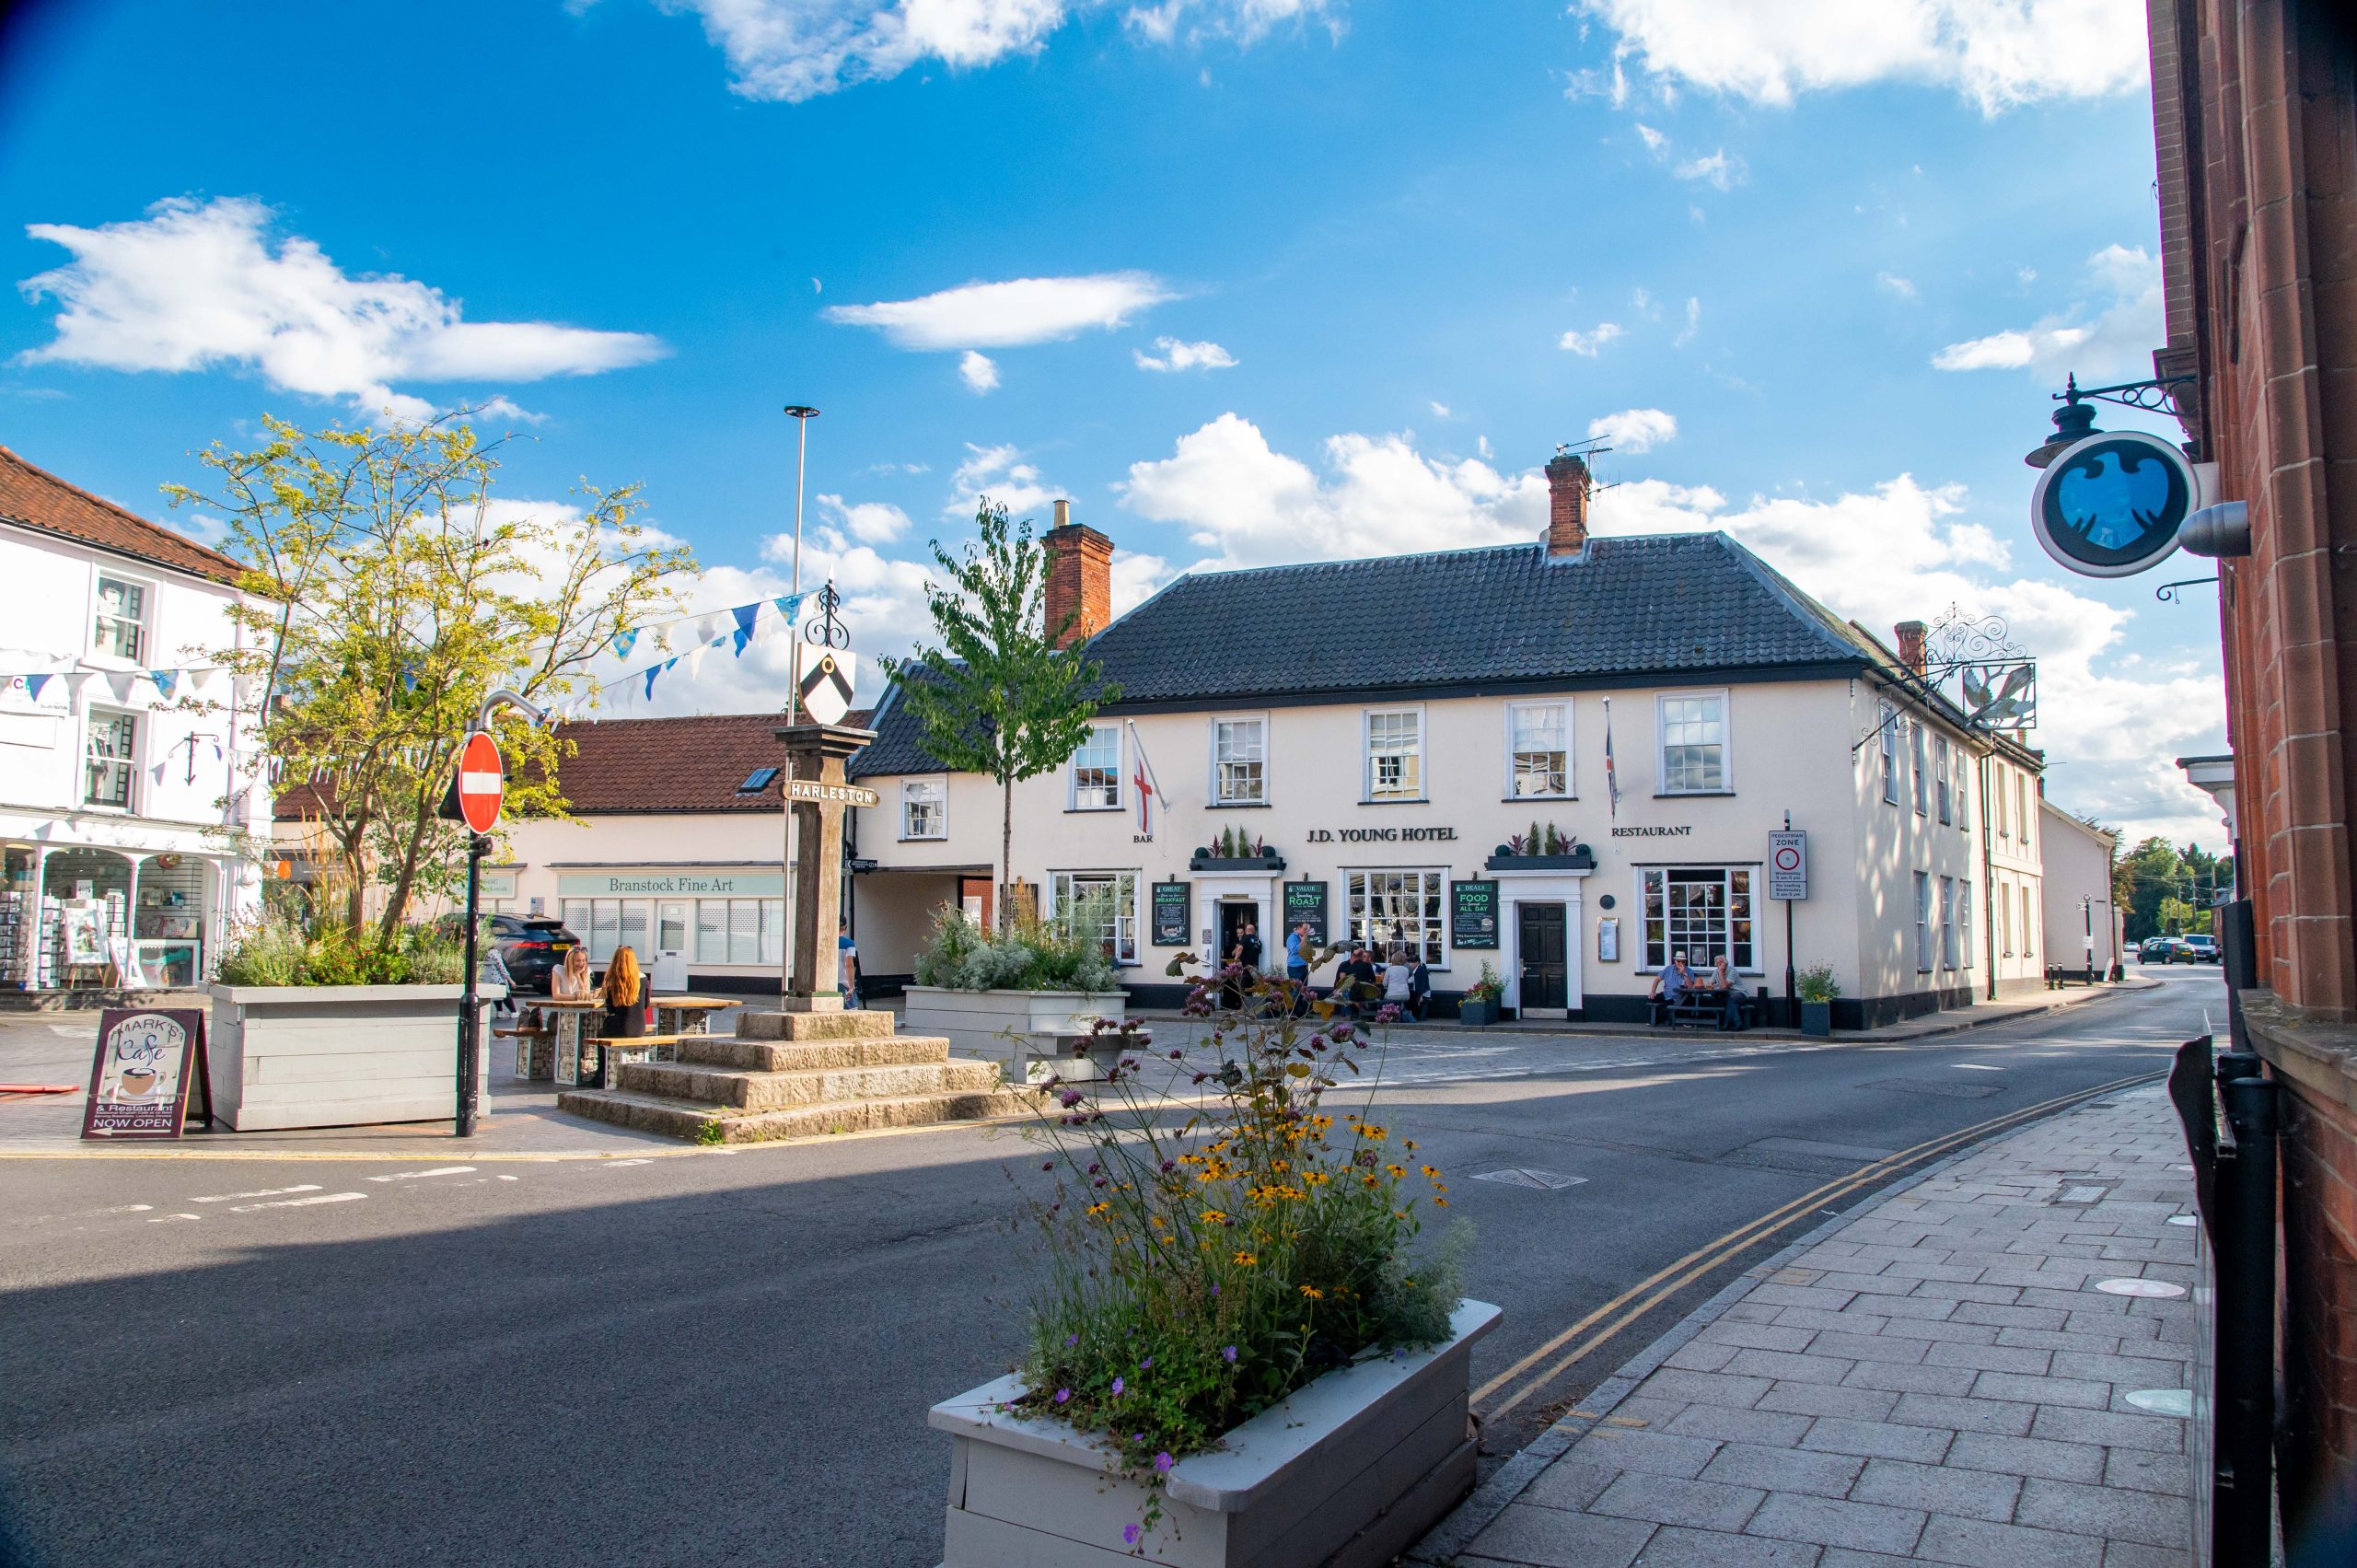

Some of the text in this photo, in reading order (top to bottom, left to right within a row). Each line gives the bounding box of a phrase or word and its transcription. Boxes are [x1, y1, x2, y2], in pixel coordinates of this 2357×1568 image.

[791, 784, 873, 803] HARLESTON
[1306, 827, 1458, 842] J.D. YOUNG HOTEL
[1611, 826, 1692, 837] RESTAURANT
[1133, 834, 1153, 843] BAR
[610, 877, 734, 891] Branstock Fine Art
[1289, 896, 1322, 905] ROAST
[1459, 894, 1488, 902] FOOD
[93, 1119, 172, 1127] NOW OPEN
